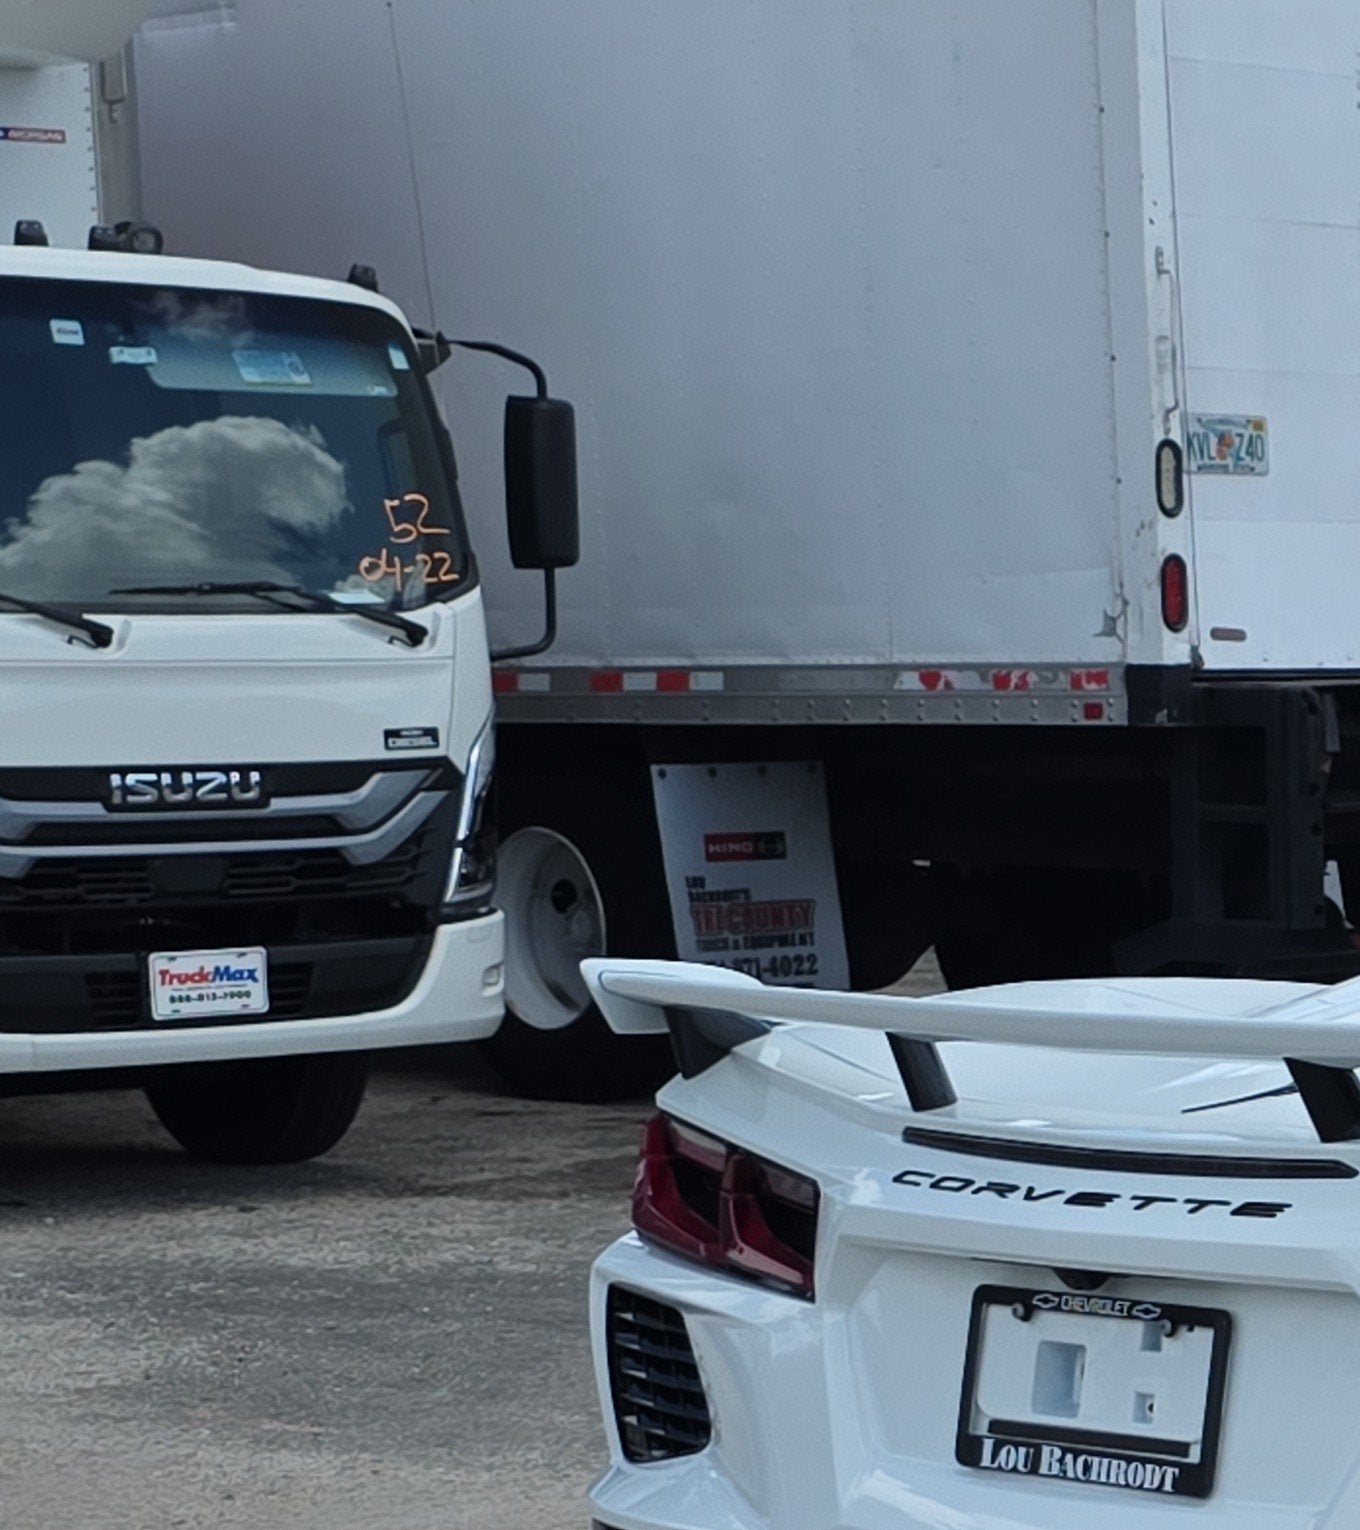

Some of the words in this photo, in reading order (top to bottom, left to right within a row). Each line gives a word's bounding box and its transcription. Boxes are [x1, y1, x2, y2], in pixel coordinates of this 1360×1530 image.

[384, 493, 451, 544] 52
[109, 771, 260, 804] ISUZU
[708, 842, 754, 853] HINO
[158, 965, 260, 986] TruckMax
[892, 1169, 1293, 1218] CORVETTE
[1060, 1294, 1132, 1317] CHEVROLET
